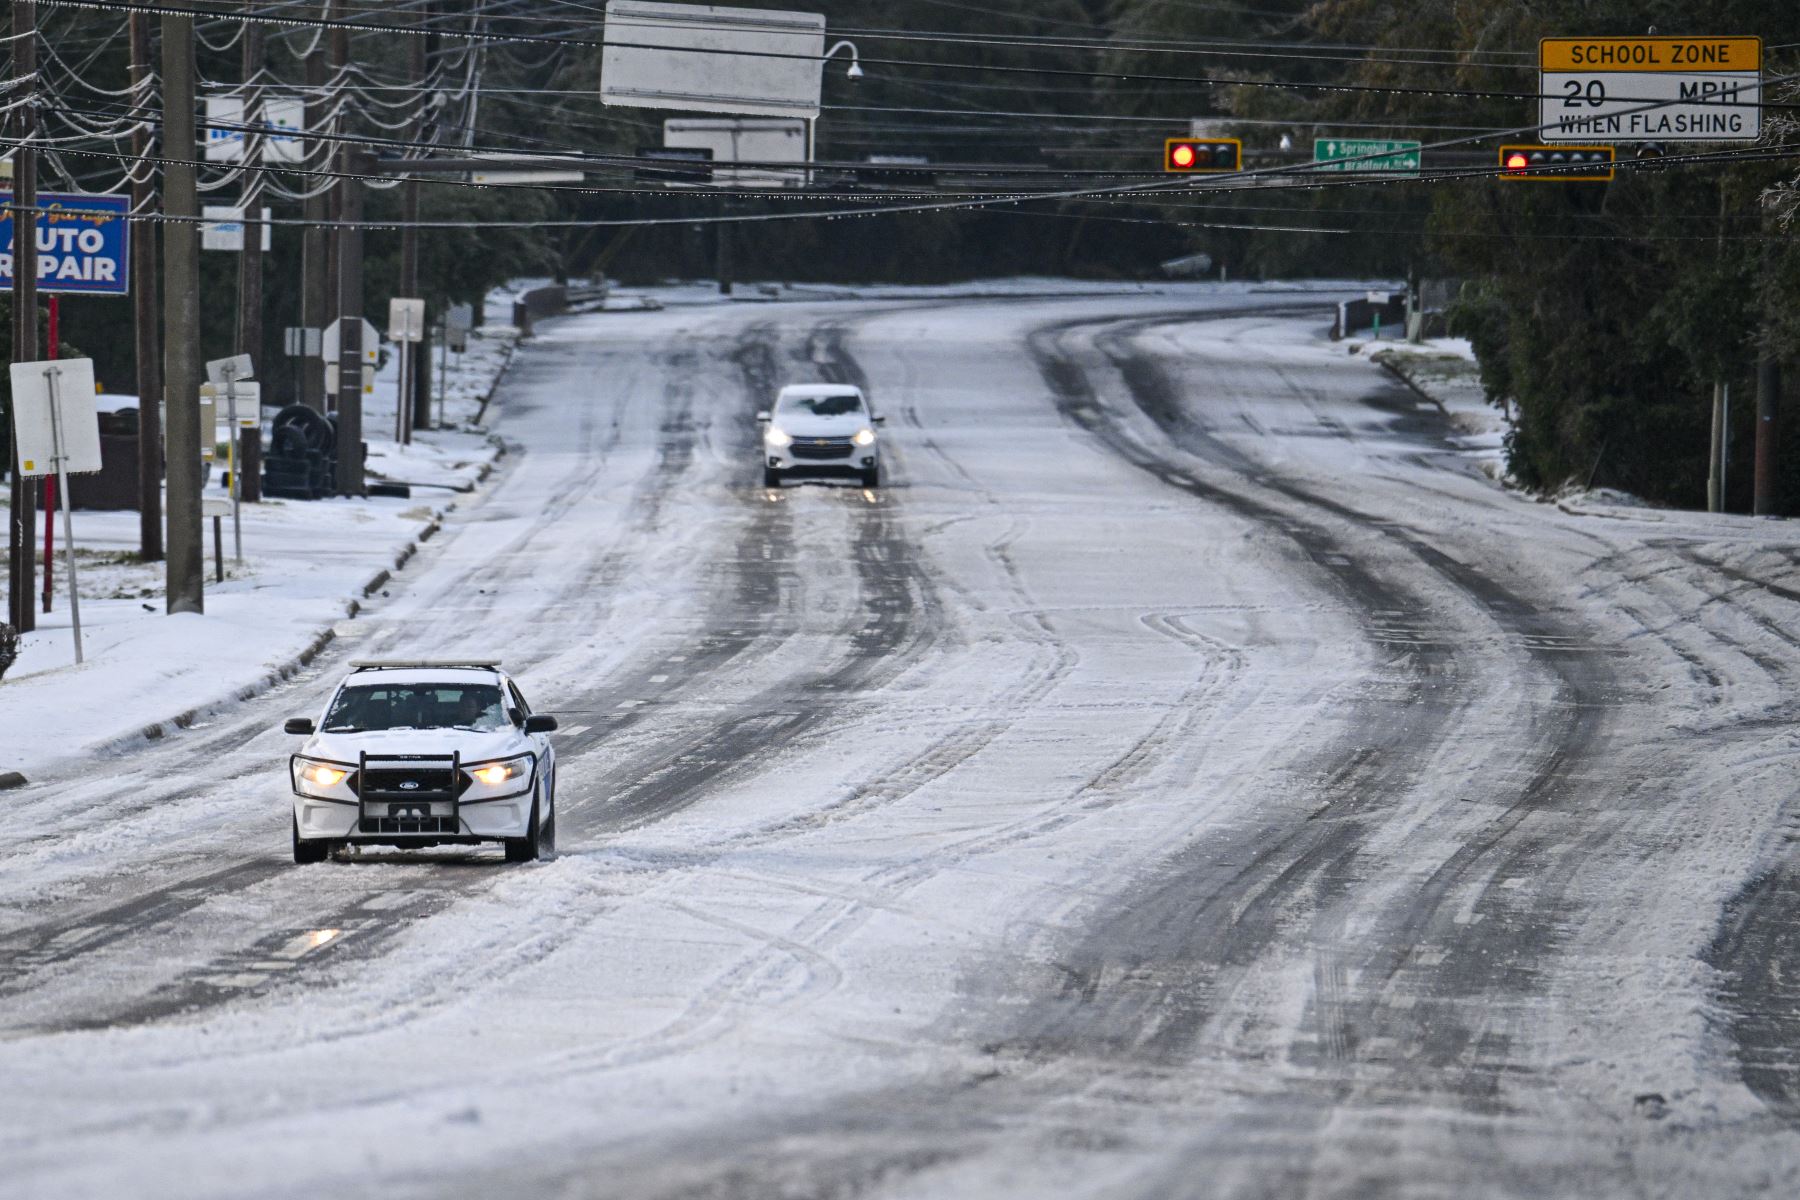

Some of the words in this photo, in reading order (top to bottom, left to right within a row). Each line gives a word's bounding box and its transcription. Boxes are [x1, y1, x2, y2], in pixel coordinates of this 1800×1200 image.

[1571, 45, 1660, 64] SCHOOL
[1671, 44, 1730, 63] ZONE
[1563, 80, 1606, 108] 20
[1680, 81, 1738, 104] MPH
[1559, 114, 1620, 134] WHEN
[1630, 113, 1742, 134] FLASHING
[1340, 142, 1387, 157] Springhill
[1344, 160, 1390, 170] Bradford
[8, 227, 104, 253] UTO
[0, 253, 116, 281] RPAIR
